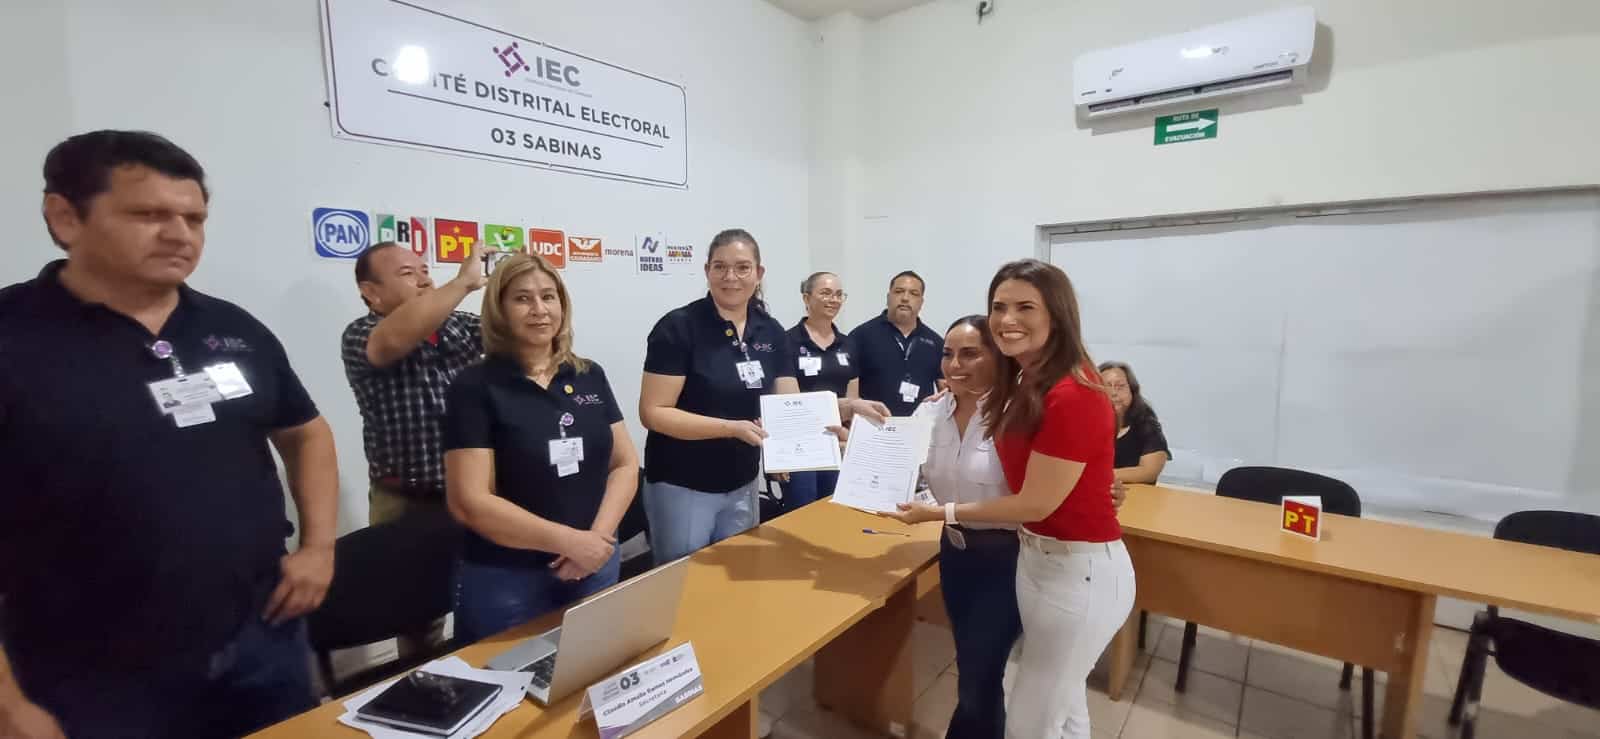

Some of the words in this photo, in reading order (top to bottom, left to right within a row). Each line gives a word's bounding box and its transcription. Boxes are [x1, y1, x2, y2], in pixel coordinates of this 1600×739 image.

[536, 56, 581, 87] IEC
[371, 58, 468, 94] CITÉ
[475, 81, 576, 118] DISTRITAL
[581, 106, 671, 139] ELECTORAL
[490, 127, 516, 146] 03
[523, 133, 602, 160] SABINAS
[324, 223, 361, 244] PAN
[440, 234, 474, 259] PT
[533, 241, 562, 256] UDC
[605, 248, 634, 257] morena
[640, 263, 664, 272] IDEAS
[1285, 510, 1315, 534] PT
[619, 671, 641, 690] 03
